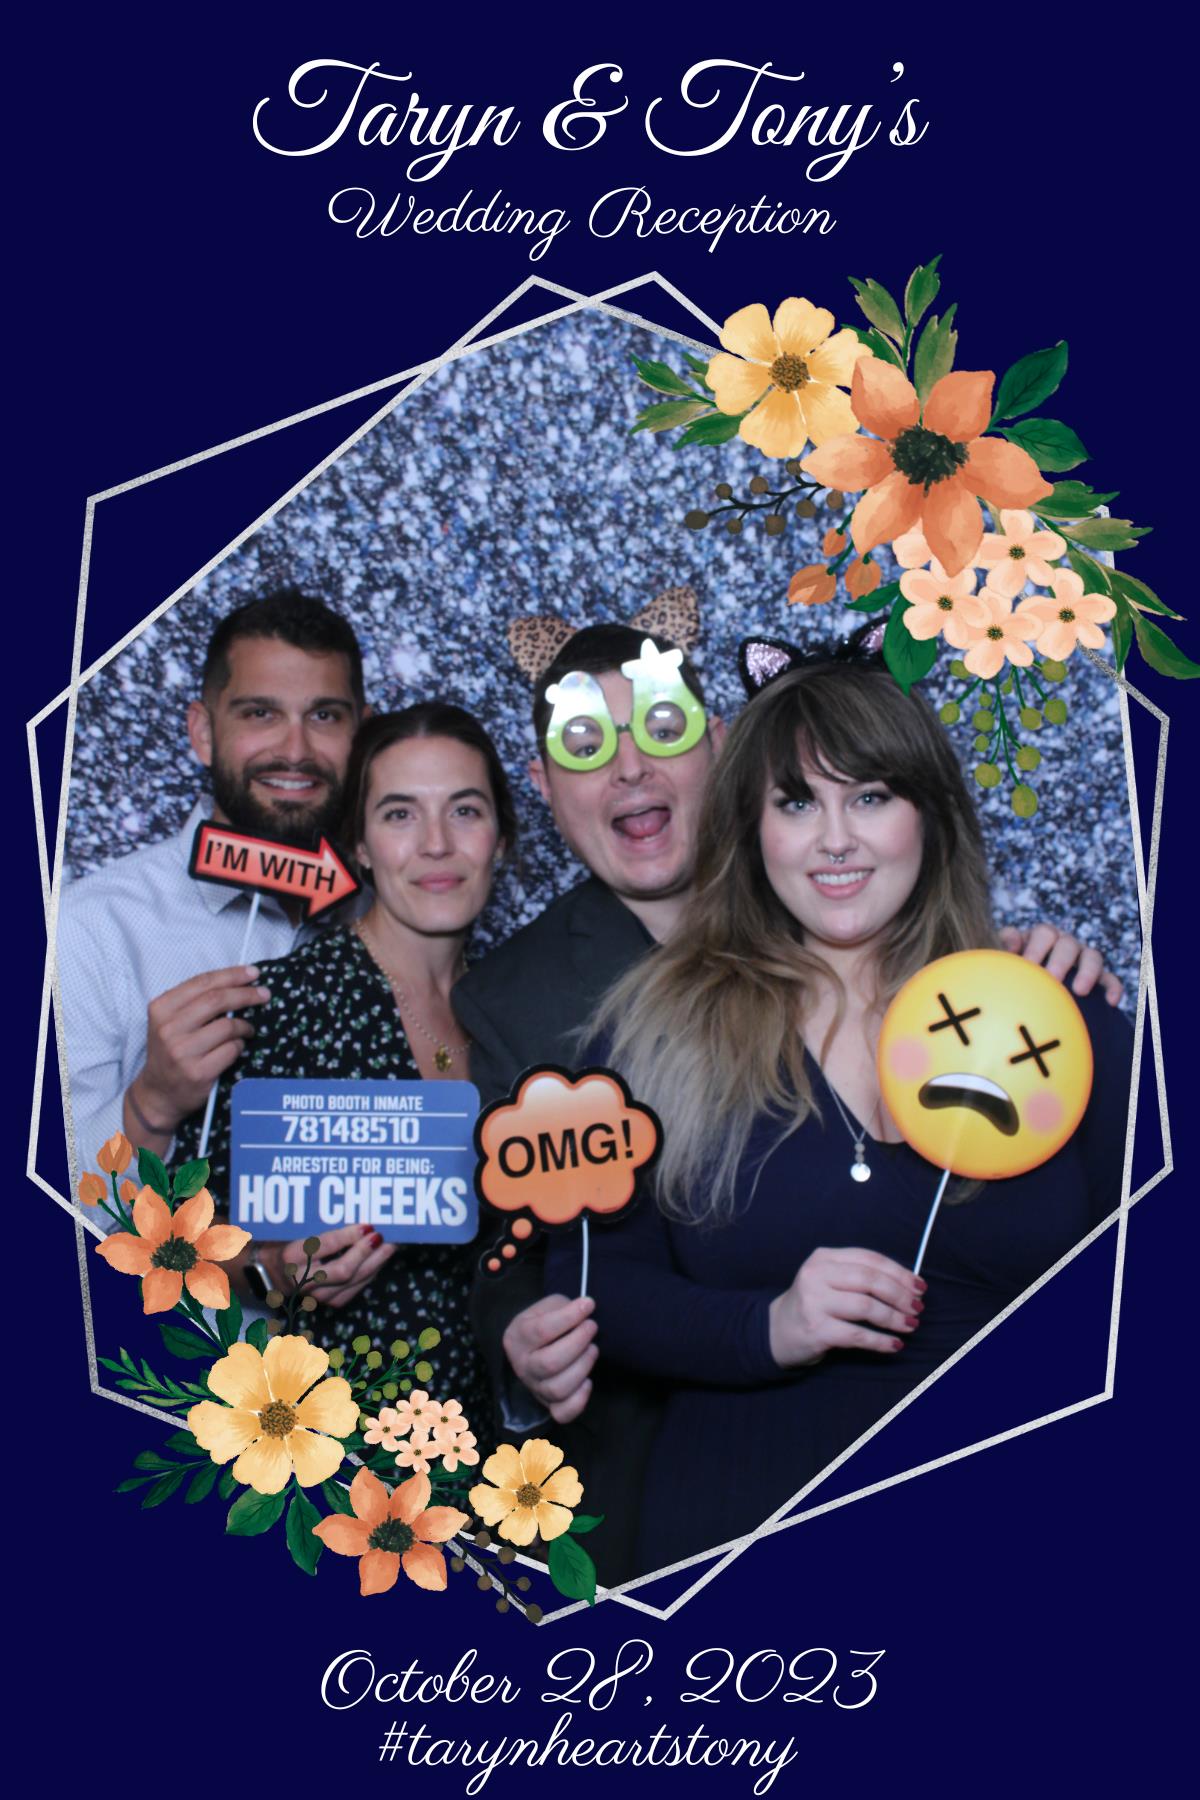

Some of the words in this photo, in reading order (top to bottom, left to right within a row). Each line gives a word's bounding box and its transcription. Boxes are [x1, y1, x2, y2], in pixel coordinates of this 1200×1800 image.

[260, 852, 336, 893] WITH
[283, 1094, 324, 1110] PHOTO
[328, 1095, 369, 1111] BOOTH
[374, 1096, 423, 1111] INMATE
[282, 1116, 420, 1144] 78148510
[272, 1156, 348, 1174] ARRESTED
[353, 1157, 381, 1174] FOR
[386, 1158, 435, 1175] BEING:
[498, 1119, 634, 1178] OMG!
[239, 1175, 311, 1224] HOT
[319, 1176, 467, 1226] CHEEKS
